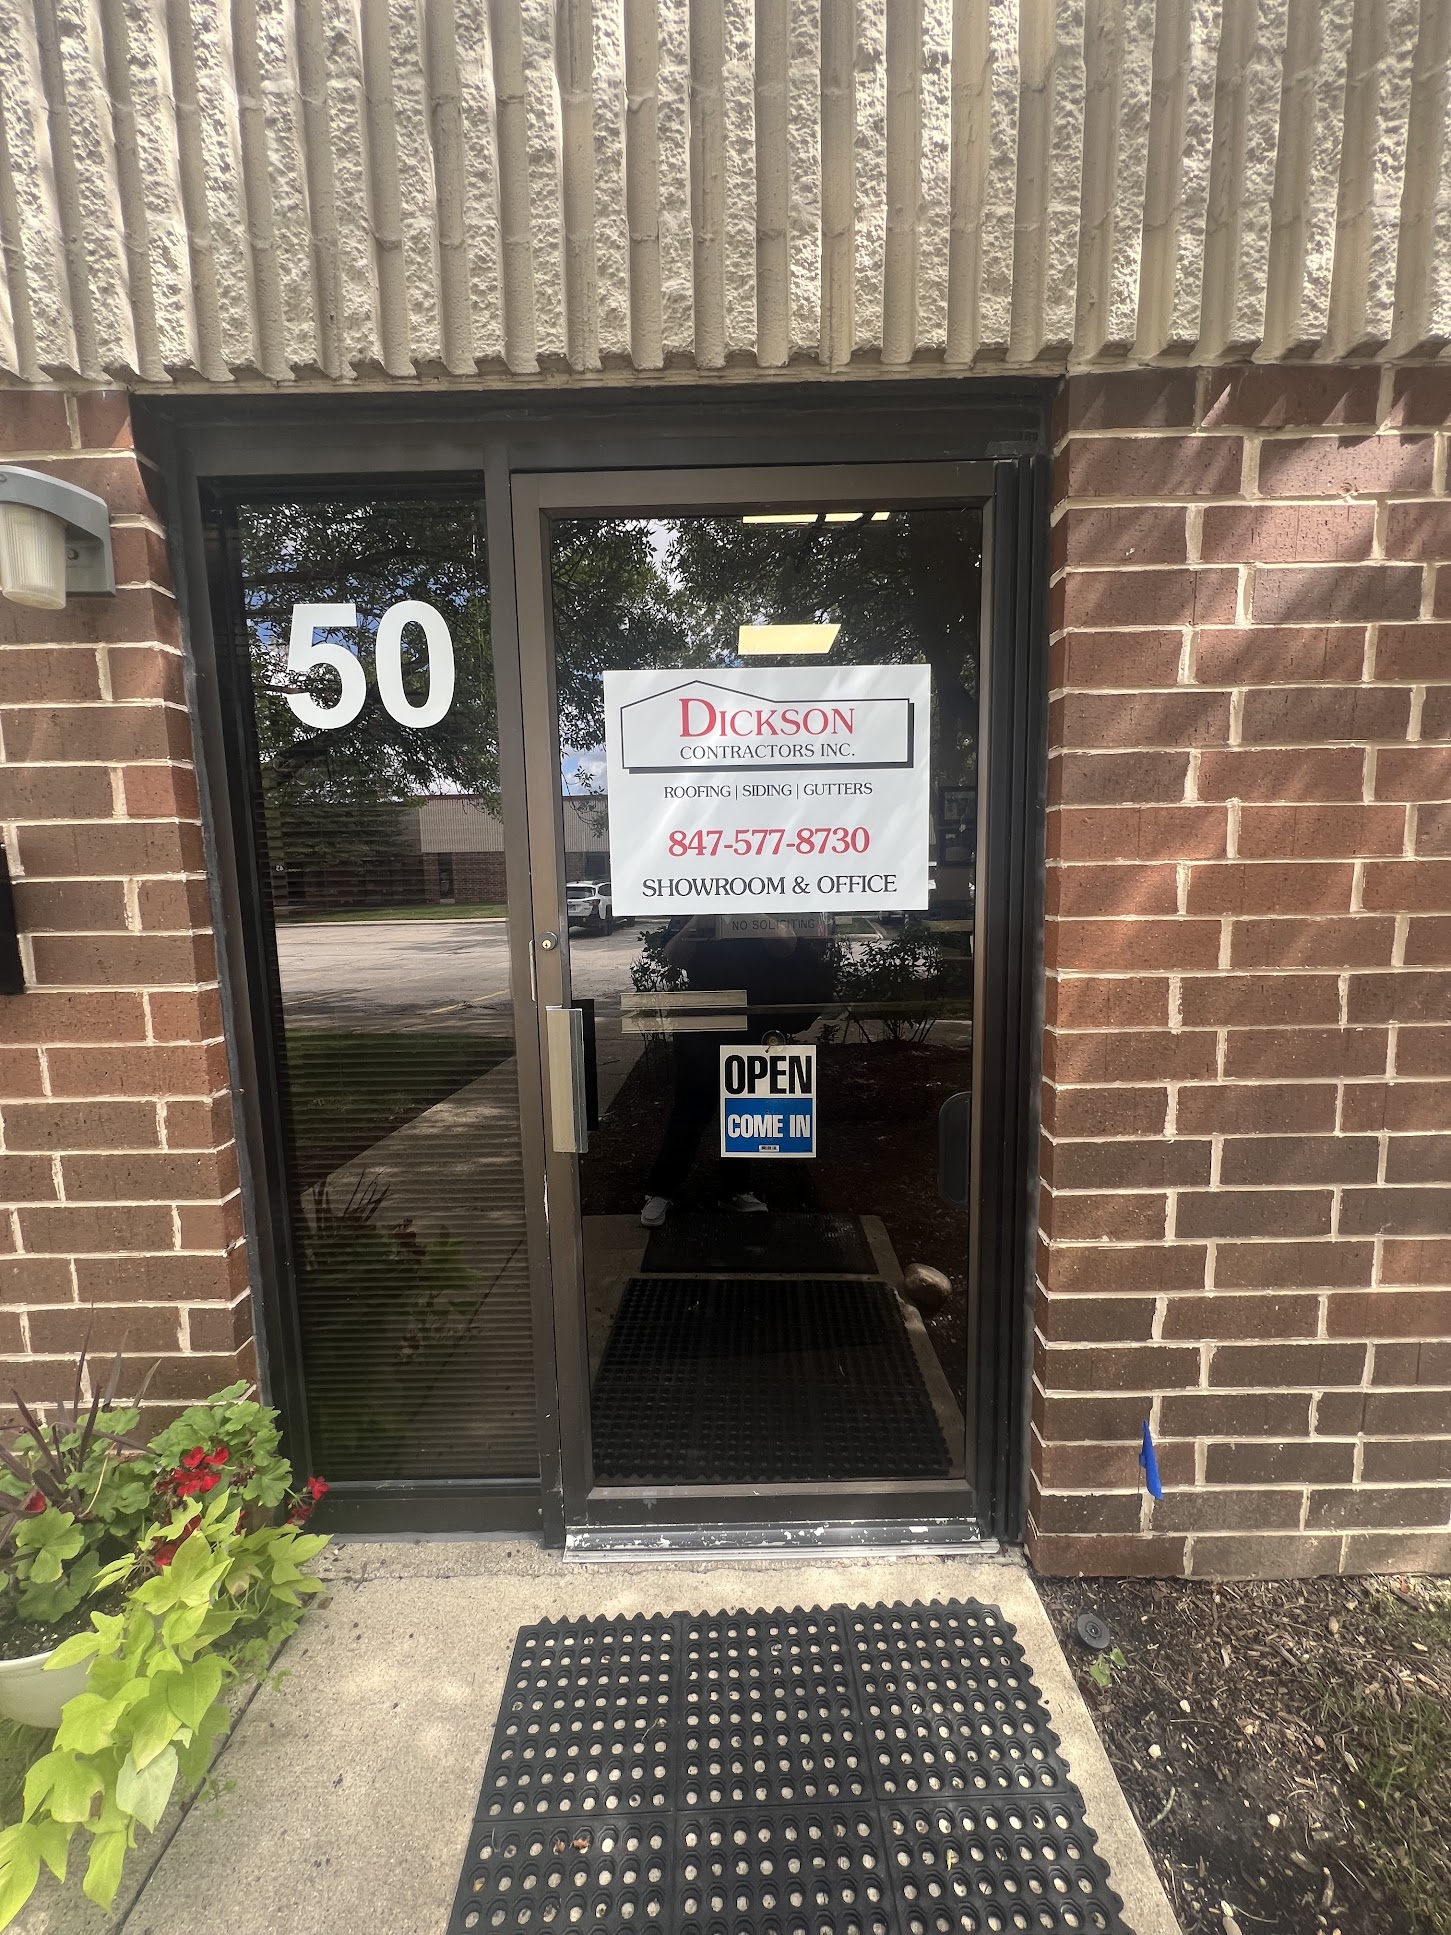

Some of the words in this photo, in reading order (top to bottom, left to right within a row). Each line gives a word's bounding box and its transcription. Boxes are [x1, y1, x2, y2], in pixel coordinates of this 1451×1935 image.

[286, 600, 455, 729] 50
[680, 743, 816, 760] CONTRACTORS
[820, 742, 856, 757] INC.
[663, 785, 732, 799] ROOFING
[741, 783, 792, 798] SIDING
[803, 782, 874, 797] GUTTERS
[668, 826, 871, 857] 847-577-8730
[641, 876, 786, 898] SHOWROOM
[791, 876, 810, 895] &
[816, 874, 898, 894] OFFICE
[732, 920, 748, 931] NO
[724, 1054, 813, 1095] OPEN
[727, 1114, 784, 1138] COME
[789, 1114, 811, 1138] IN
